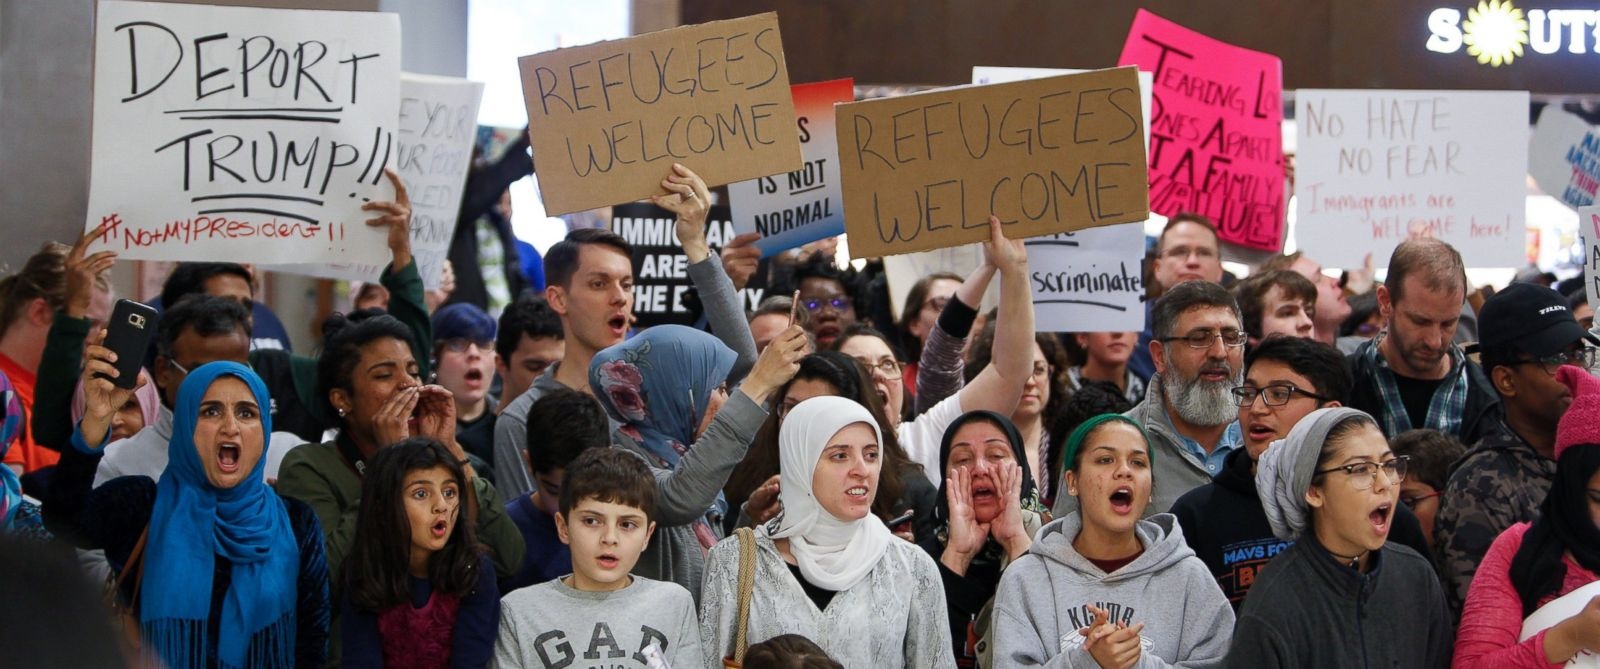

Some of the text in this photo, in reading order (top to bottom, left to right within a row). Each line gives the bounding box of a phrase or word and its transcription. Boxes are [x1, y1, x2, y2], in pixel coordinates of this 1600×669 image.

[114, 21, 380, 104] DEPORT
[535, 28, 778, 115] REFUGEES
[1142, 34, 1245, 117] TEARING
[566, 103, 778, 178] WELCOME
[853, 88, 1140, 170] REFUGEES
[1367, 97, 1450, 141] HATE
[154, 127, 391, 202] TRUMP!!
[758, 158, 827, 195] IS NOT
[1169, 148, 1194, 186] A
[1202, 155, 1277, 205] FAMILY
[1339, 141, 1464, 180] NO FEAR
[754, 197, 833, 238] NORMAL
[873, 163, 1131, 244] WELCOME
[1306, 182, 1456, 222] Immigrants are
[640, 254, 688, 278] ARE
[632, 285, 667, 312] HE
[1224, 545, 1265, 566] MAVS
